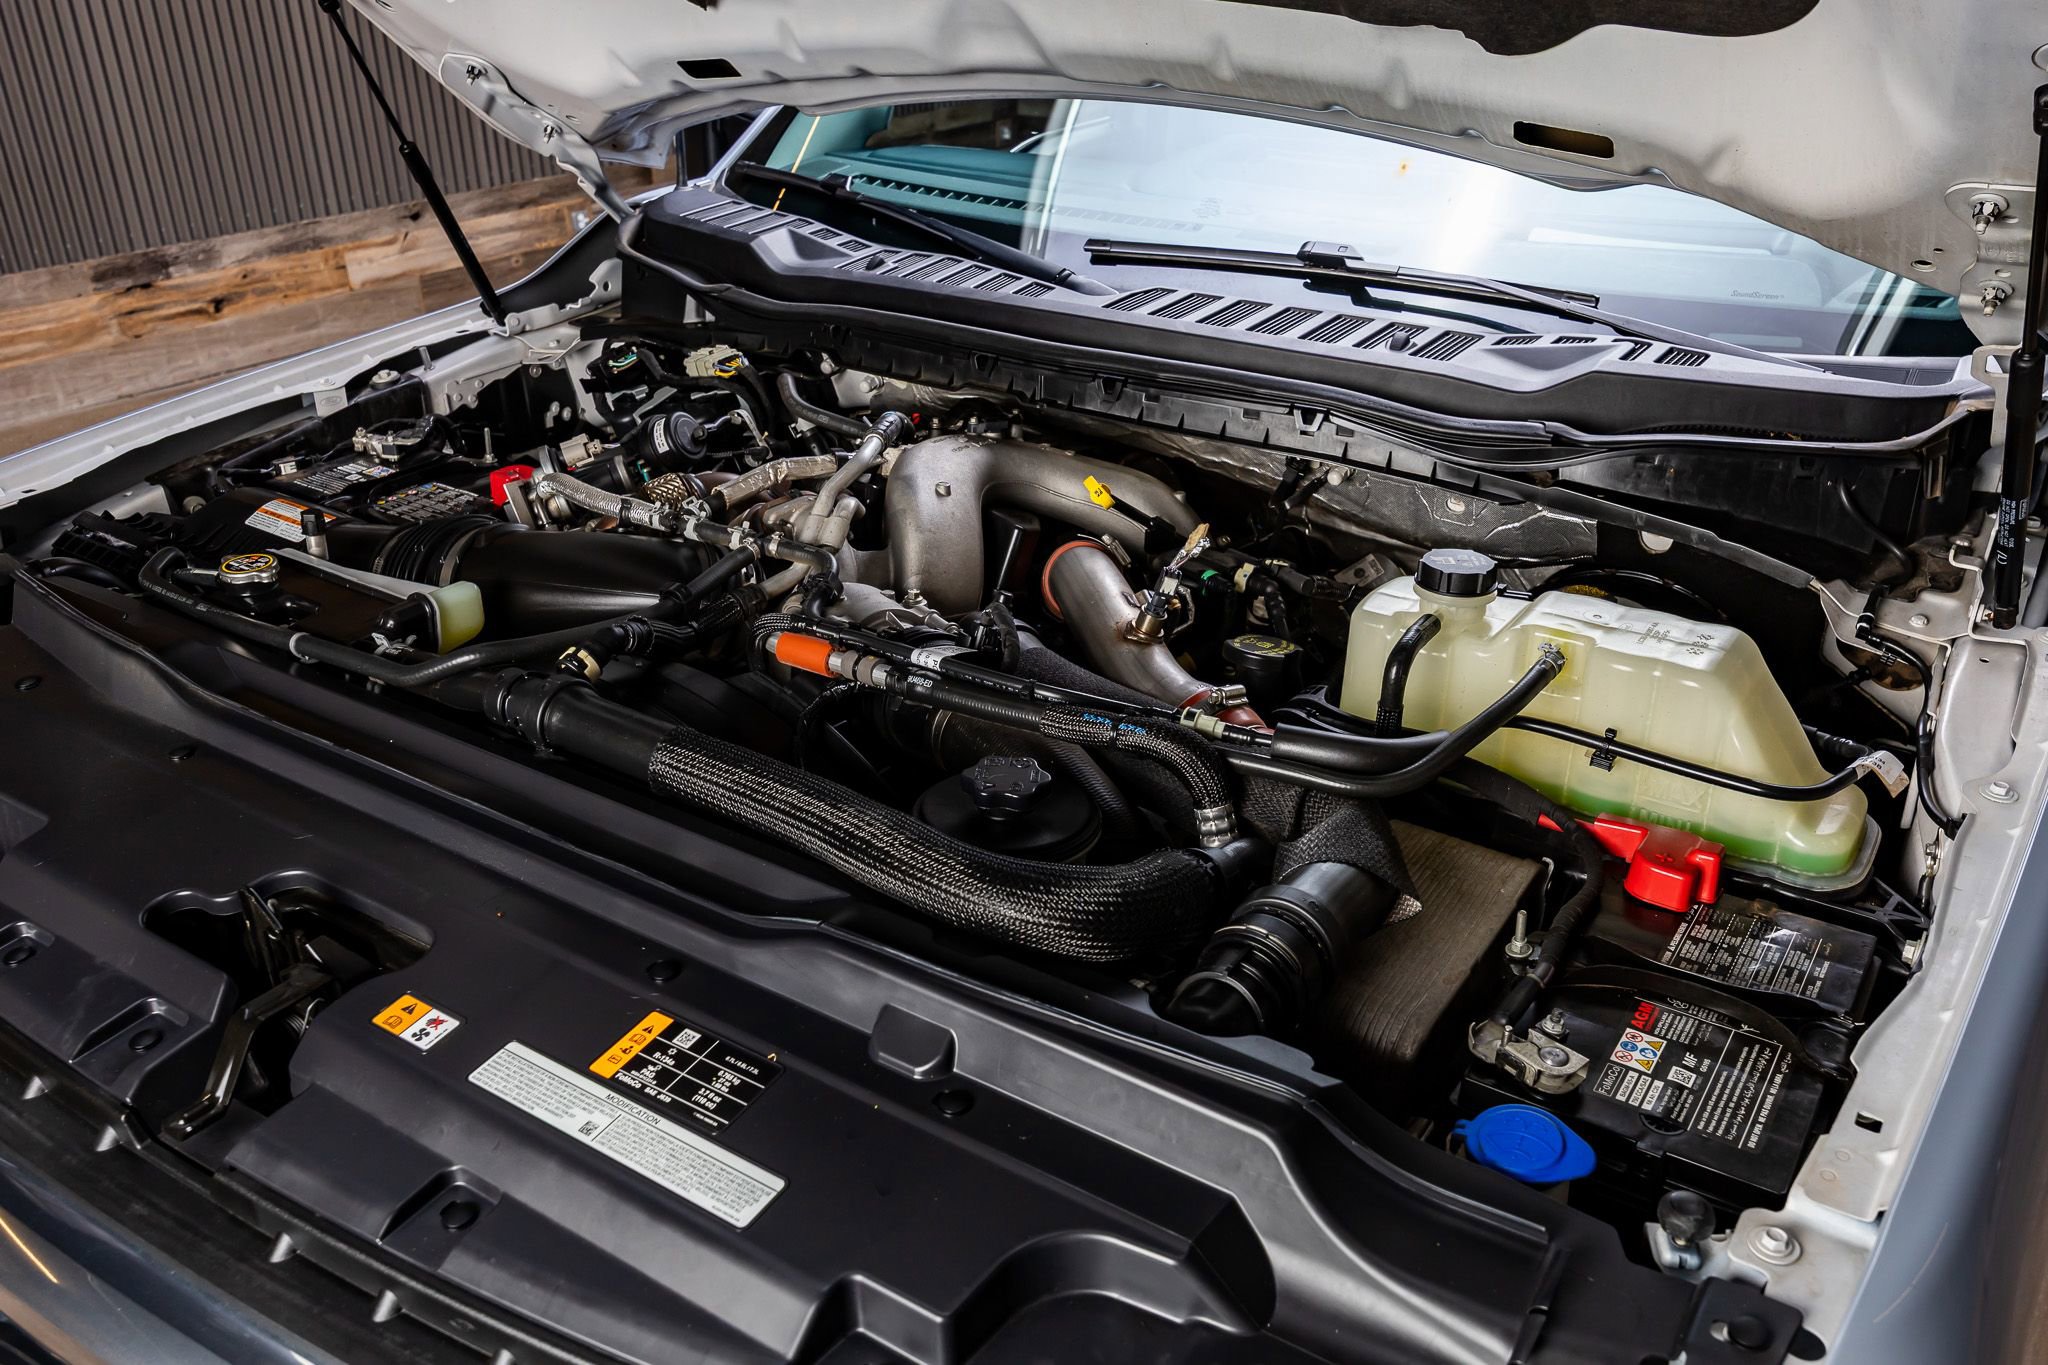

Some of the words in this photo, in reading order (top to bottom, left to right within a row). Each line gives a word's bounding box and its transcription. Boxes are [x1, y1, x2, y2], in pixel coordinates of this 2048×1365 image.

[1631, 1002, 1654, 1029] AGM
[653, 1052, 675, 1066] R-134a
[1682, 1052, 1697, 1068] MF
[615, 1072, 641, 1088] FoMoCo
[1598, 1064, 1620, 1095] FoMoCo
[605, 1094, 661, 1125] MODIFICATION
